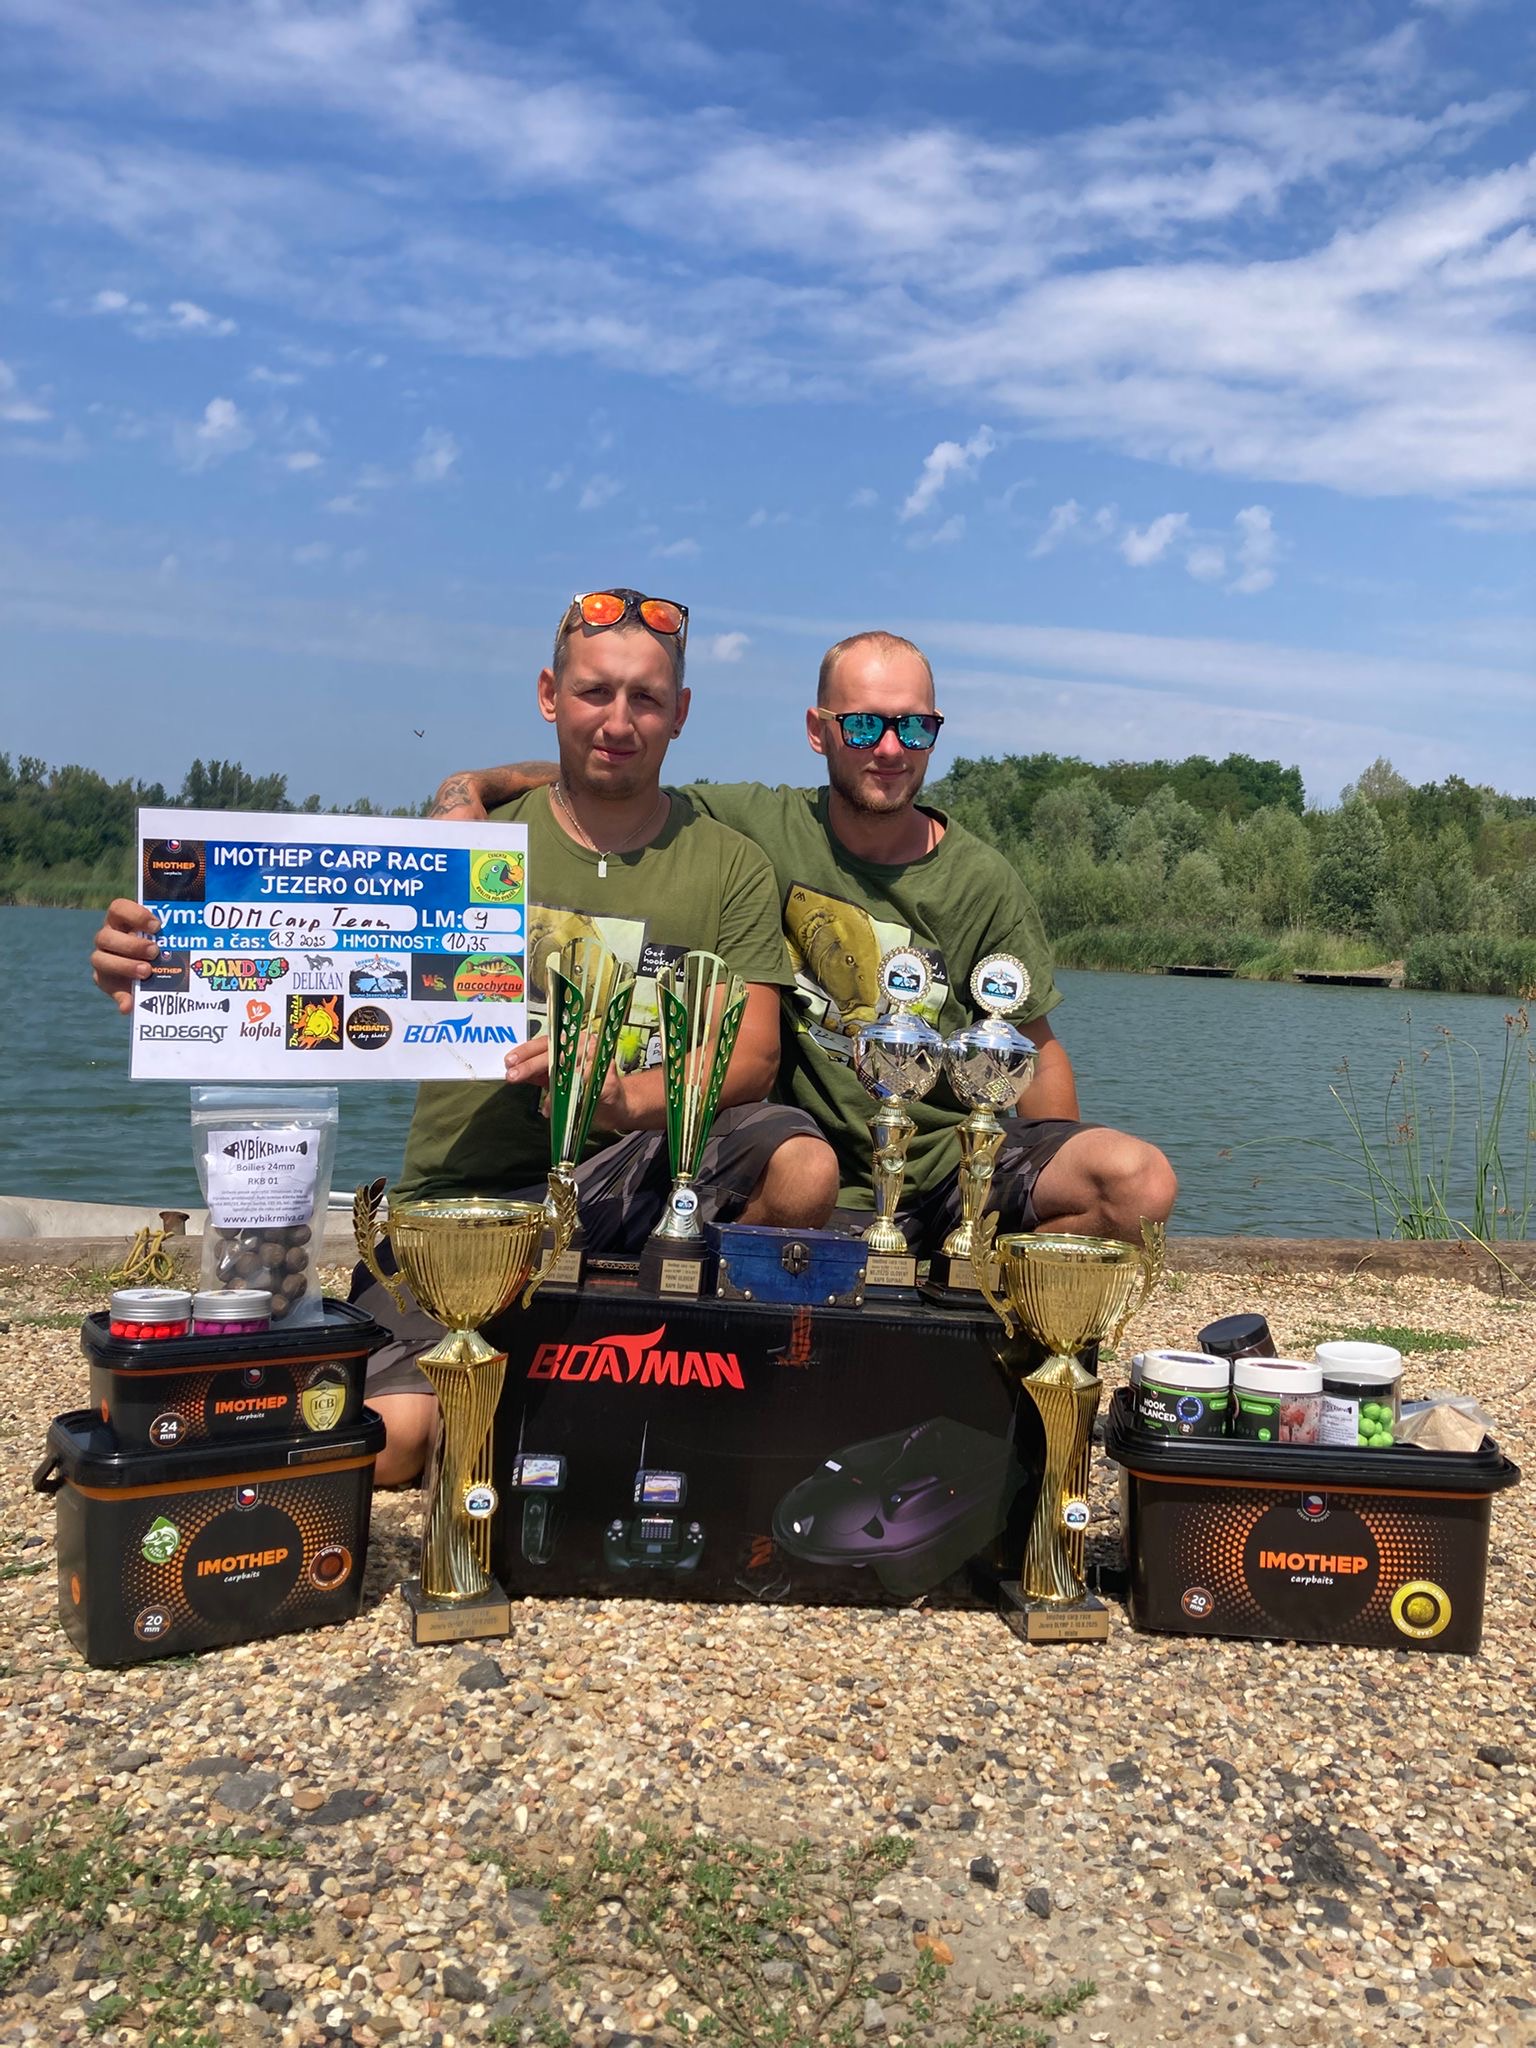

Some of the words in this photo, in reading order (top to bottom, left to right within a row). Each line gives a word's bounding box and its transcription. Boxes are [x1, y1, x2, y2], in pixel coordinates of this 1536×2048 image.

[152, 861, 196, 870] IMOTHEP
[213, 847, 312, 867] IMOTHEP
[319, 849, 381, 870] CARP
[388, 852, 448, 872] RACE
[260, 875, 348, 895] JEZERO
[354, 877, 424, 897] OLYMP
[211, 905, 263, 929] DDM
[269, 909, 321, 932] Carp
[331, 907, 390, 929] Team
[421, 909, 463, 929] LM:
[144, 933, 207, 948] atum
[213, 936, 225, 948] a
[229, 933, 266, 949] čas:
[342, 933, 440, 949] HMOTNOST:
[644, 947, 666, 957] Get
[201, 958, 282, 978] DANDYS
[643, 956, 676, 967] hooked
[150, 967, 183, 975] MOTHEP
[292, 972, 344, 990] DELIKAN
[456, 981, 523, 994] nacochytnu
[140, 1025, 228, 1044] RADEGAST
[240, 1022, 281, 1041] kofola
[403, 1013, 518, 1044] BOATMAN
[236, 1163, 266, 1171] Boilies
[267, 1163, 296, 1171] 24mm
[247, 1177, 266, 1185] RKB
[267, 1177, 279, 1185] 01
[527, 1322, 745, 1389] BOATMAN
[214, 1395, 288, 1415] IMOTHEP
[314, 1398, 335, 1410] ICB
[1143, 1398, 1166, 1411] HOOK
[160, 1421, 178, 1433] 24
[159, 1432, 176, 1440] mm
[197, 1548, 289, 1577] IMOTHEP
[1259, 1550, 1369, 1575] IMOTHEP
[224, 1571, 260, 1583] carpbaits
[1290, 1575, 1334, 1586] carpbaits
[1190, 1595, 1206, 1606] 20
[1189, 1603, 1204, 1613] mm
[145, 1615, 163, 1626] 20
